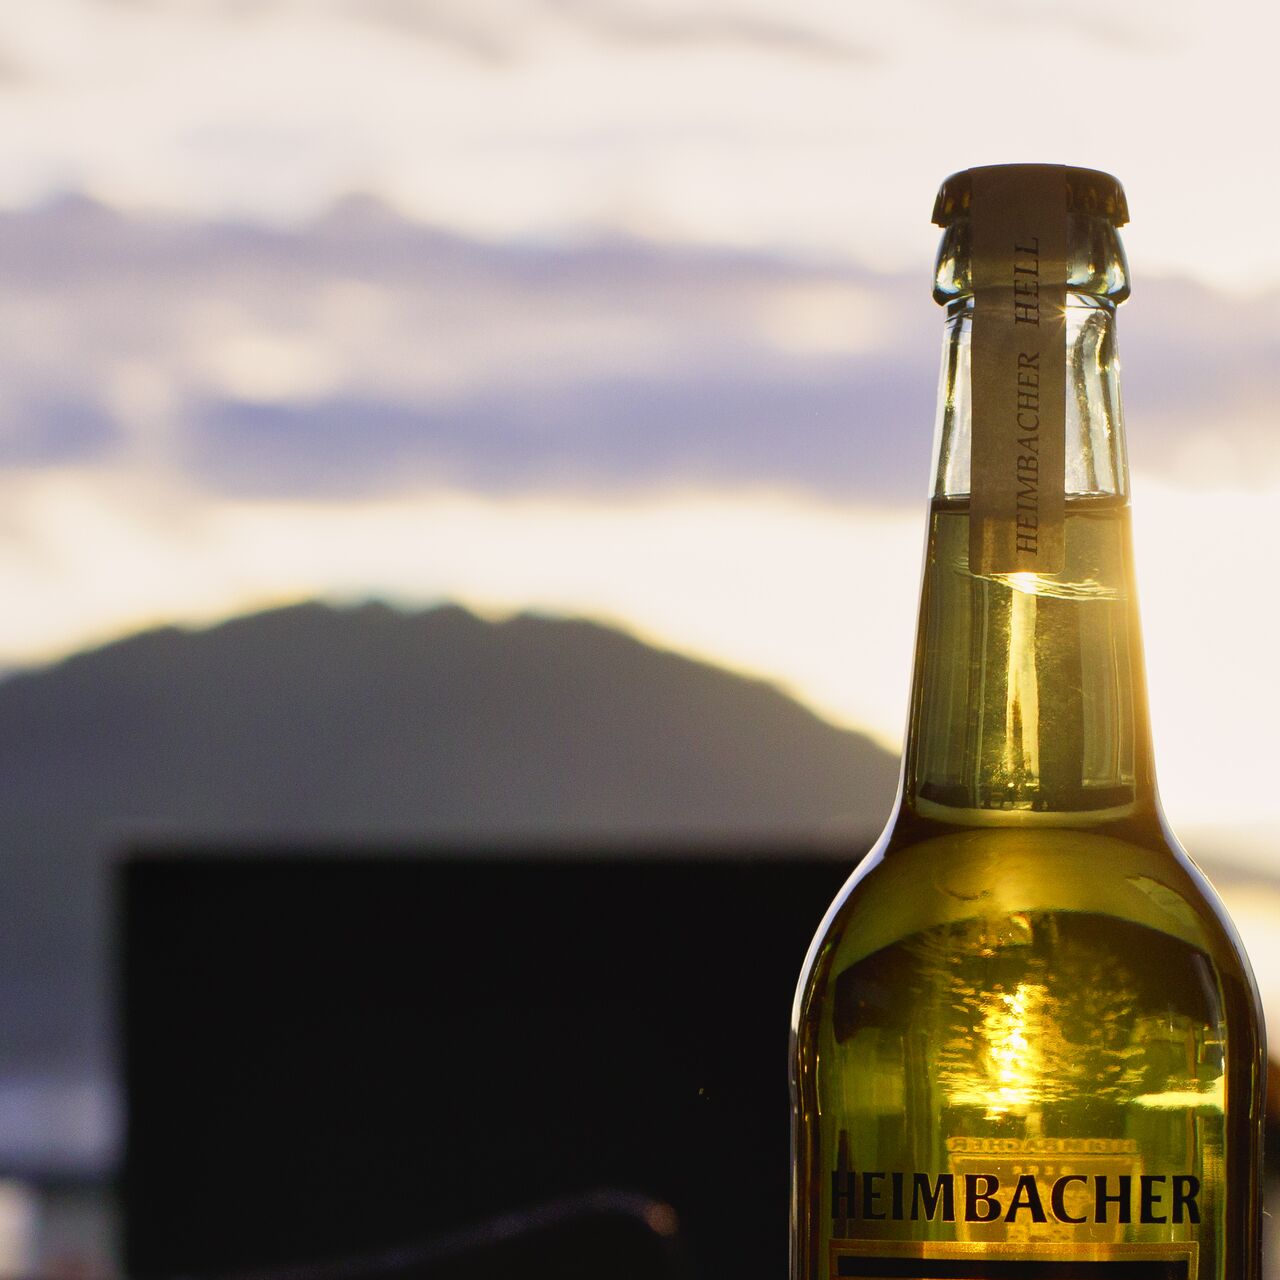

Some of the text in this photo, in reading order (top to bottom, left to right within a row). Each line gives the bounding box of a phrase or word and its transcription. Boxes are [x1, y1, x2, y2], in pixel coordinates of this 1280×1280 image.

[1014, 236, 1041, 556] HEIMBACHER HELL
[831, 1170, 1202, 1225] HEIMBACHER
